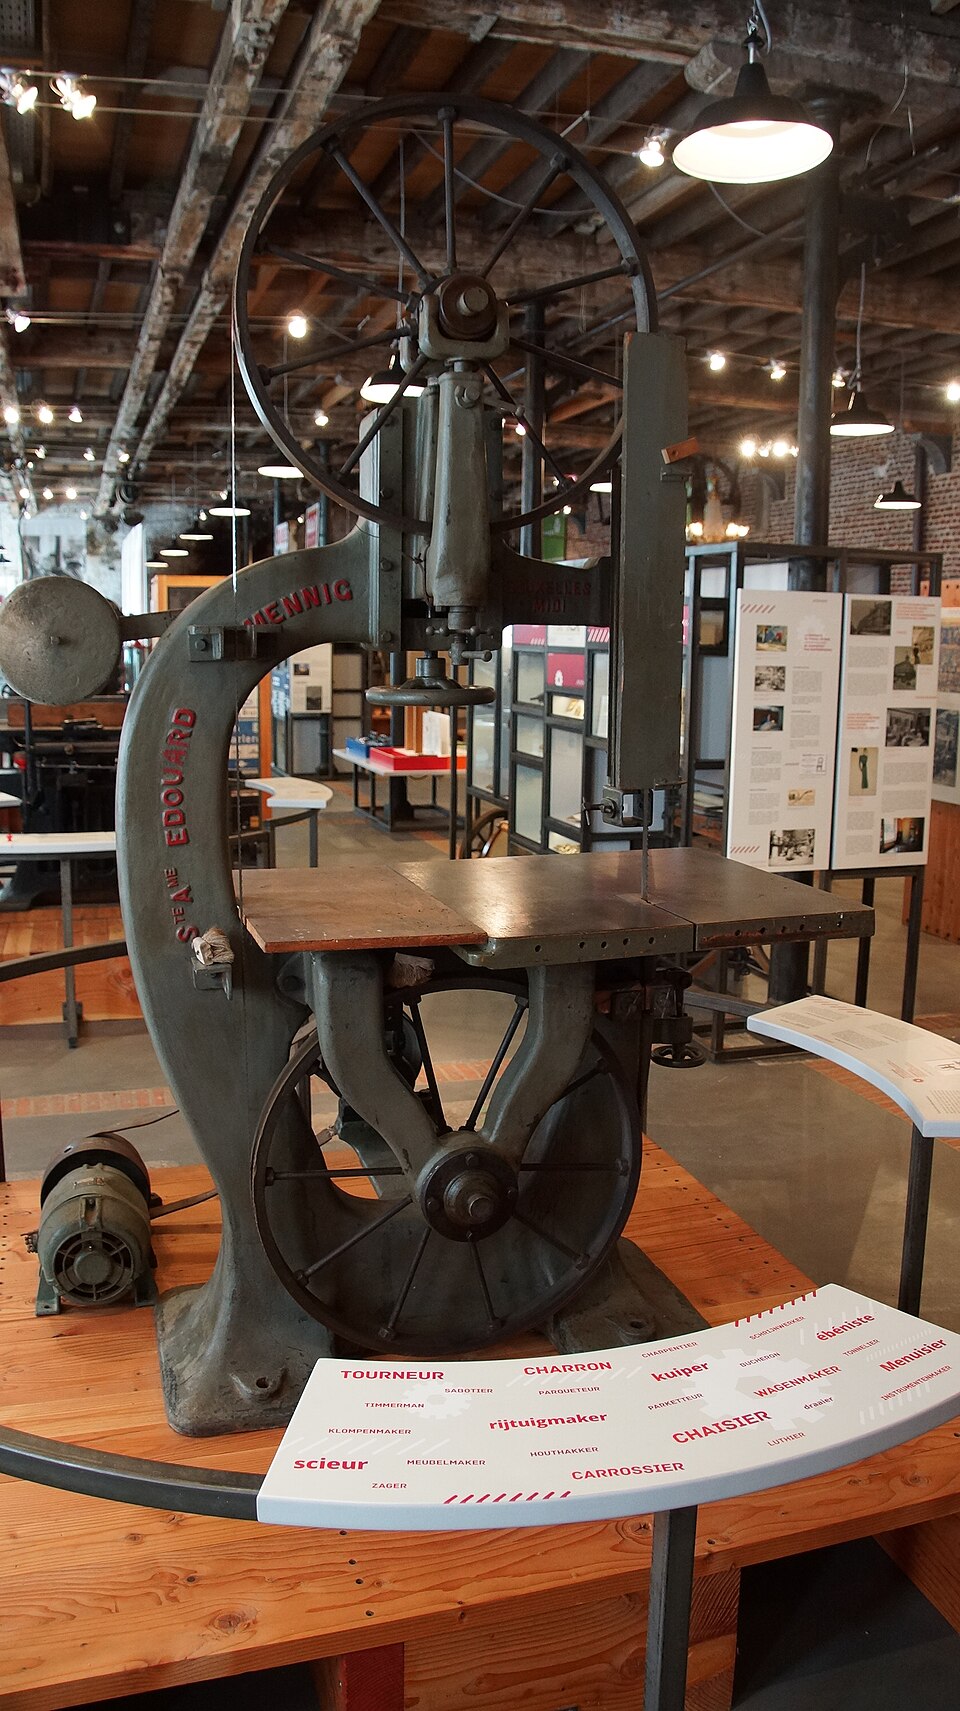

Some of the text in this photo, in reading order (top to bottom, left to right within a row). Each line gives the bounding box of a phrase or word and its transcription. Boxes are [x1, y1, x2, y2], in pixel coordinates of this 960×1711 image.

[532, 599, 566, 613] MIDI
[162, 707, 197, 847] EDOUARD
[243, 578, 353, 627] MENNIG
[749, 1315, 807, 1341] SCHRIJNWERKER
[816, 1314, 876, 1342] ébéniste
[641, 1341, 699, 1359] CHARPENTIER
[842, 1338, 881, 1357] TONNELIER
[879, 1338, 948, 1373] Menuisier
[523, 1361, 613, 1376] CHARRON
[739, 1351, 781, 1368] BUCHERON
[340, 1370, 445, 1381] TOURNEUR
[651, 1362, 709, 1382] kuiper
[753, 1365, 843, 1398] WAGENMAKER
[880, 1365, 952, 1402] INSTRUMENTENMAKER
[538, 1386, 601, 1396] PARQUETEUR
[647, 1393, 704, 1411] PARKETTEUR
[803, 1396, 834, 1410] draaier
[489, 1413, 608, 1432] rijtuigmaker
[672, 1411, 773, 1444] CHAISIER
[767, 1431, 806, 1447] LUTHIER
[529, 1446, 599, 1458] HOUTHAKKER
[293, 1457, 369, 1471] scieur
[572, 1462, 685, 1481] CARROSSIER
